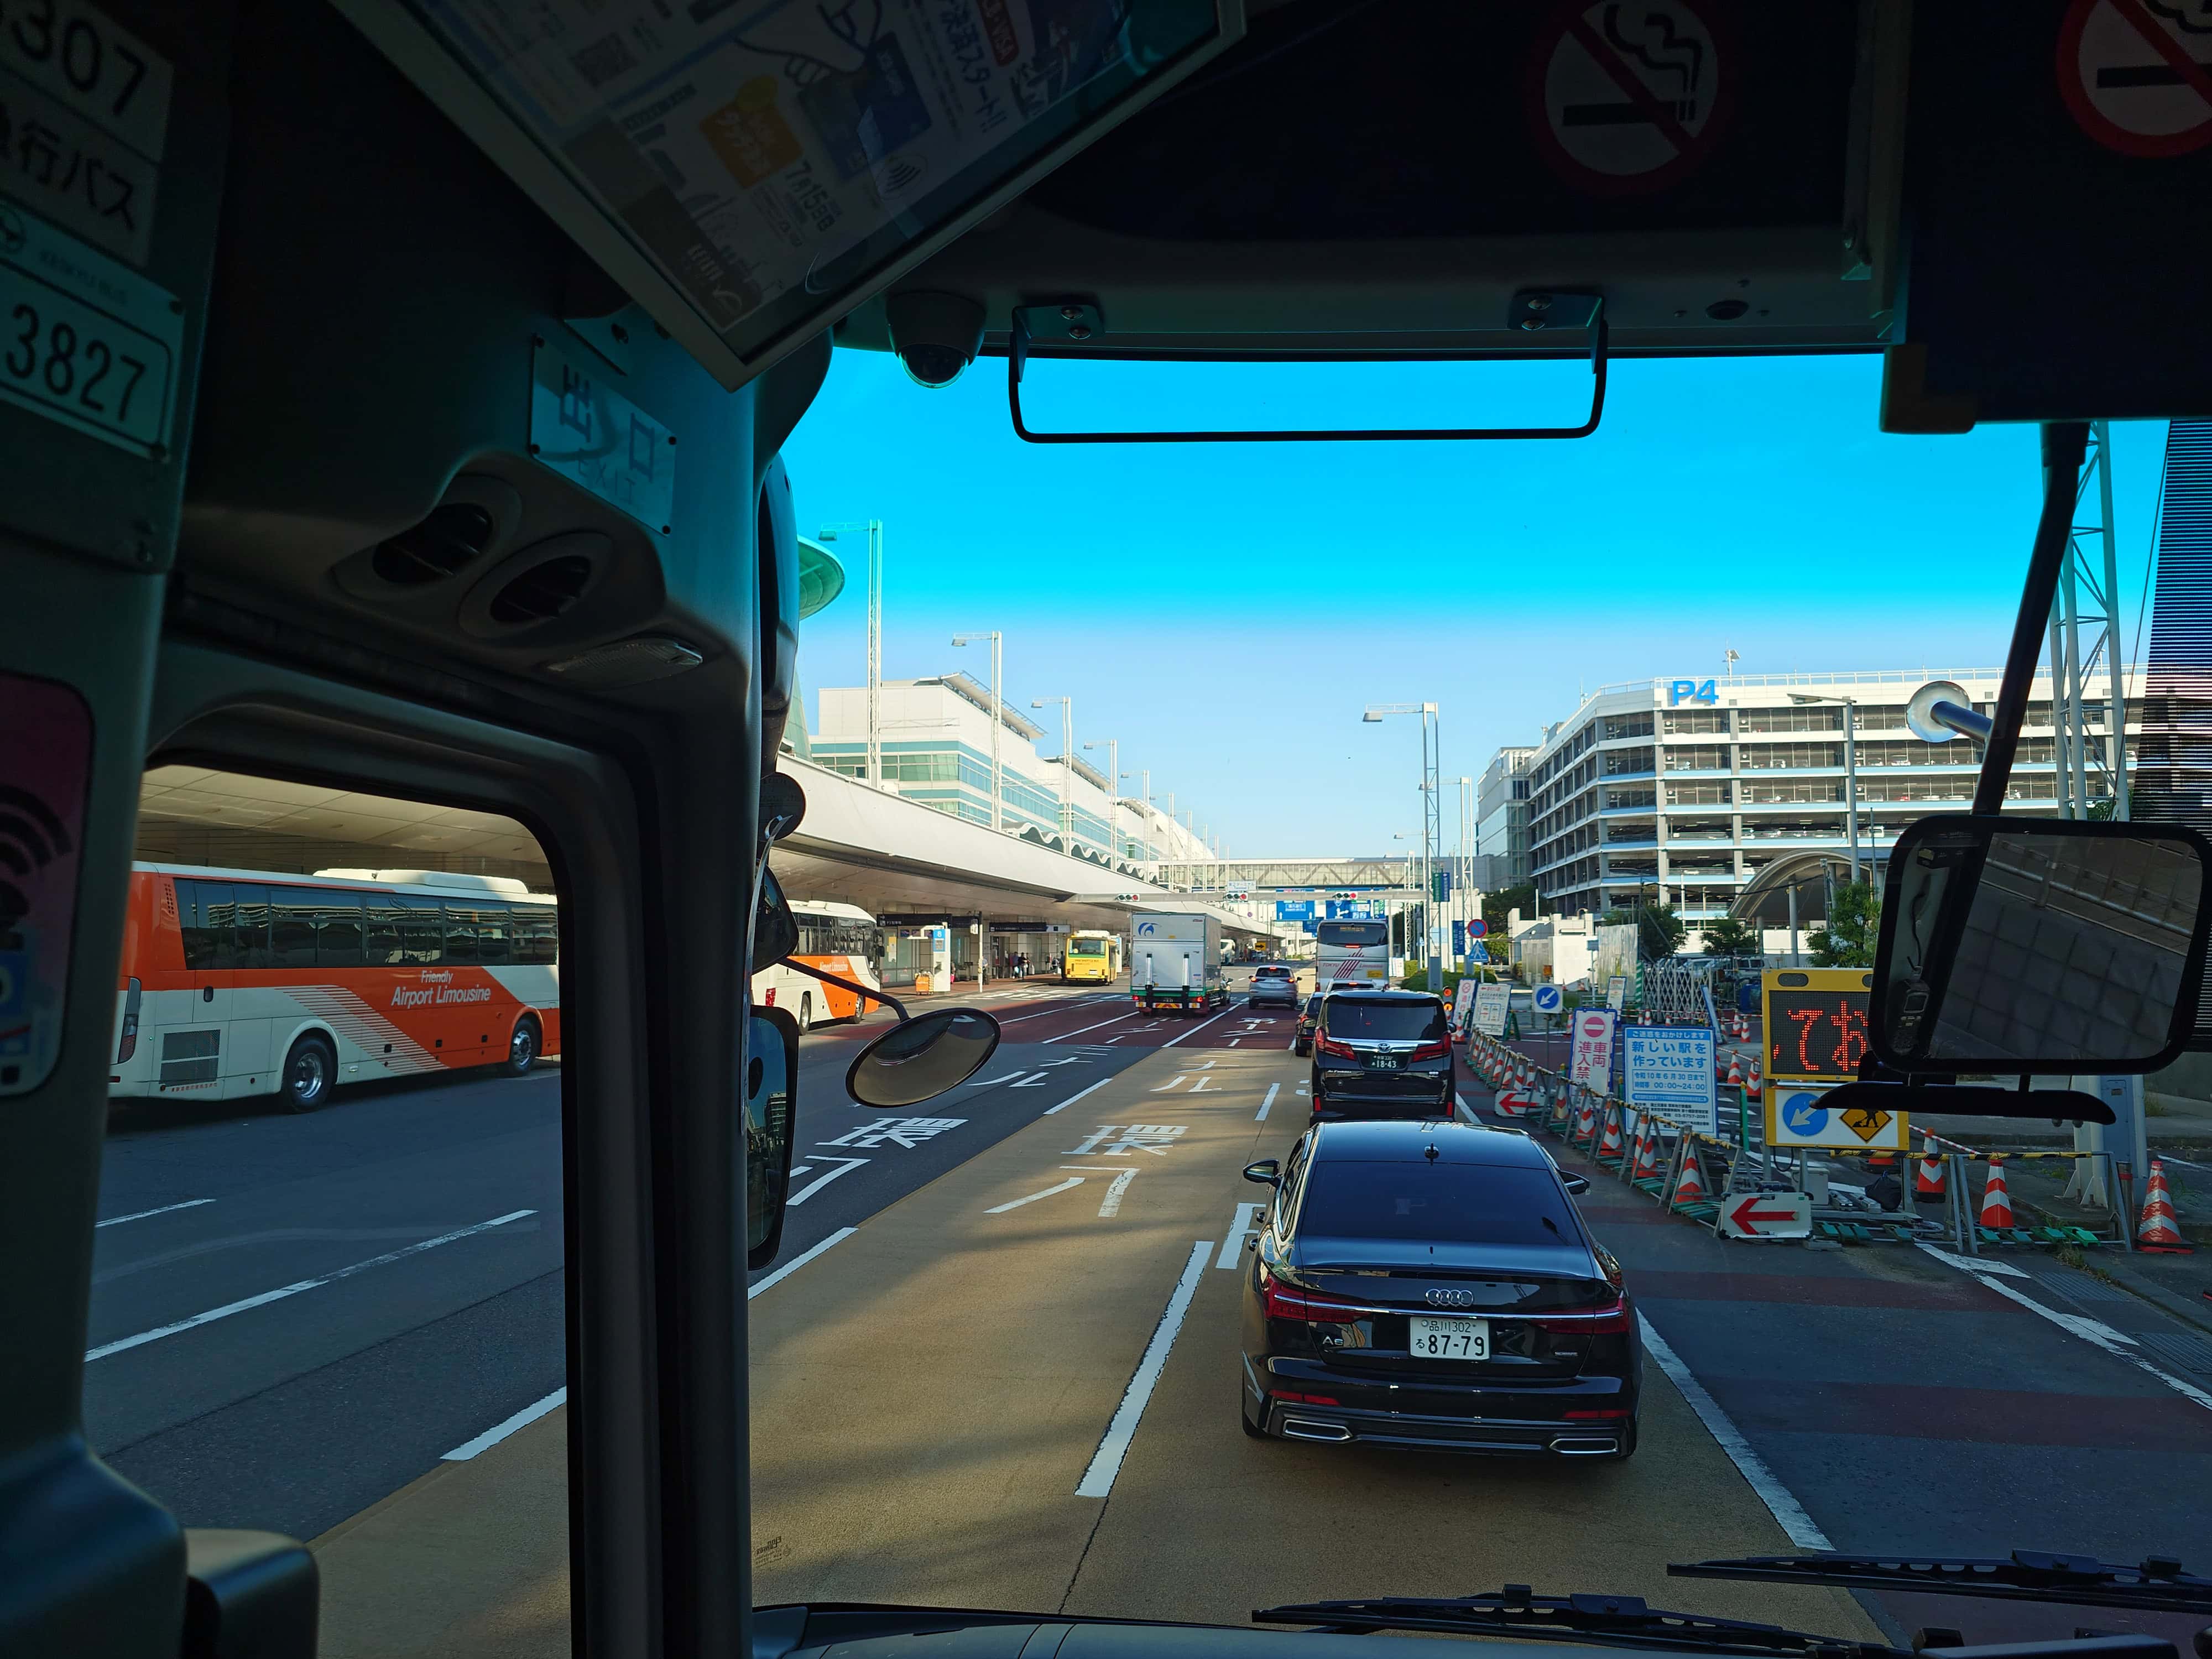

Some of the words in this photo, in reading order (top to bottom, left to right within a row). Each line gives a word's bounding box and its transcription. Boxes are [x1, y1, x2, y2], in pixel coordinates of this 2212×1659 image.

[7, 304, 146, 421] 3827
[560, 364, 654, 483] 出口
[1673, 680, 1719, 705] P4
[421, 969, 453, 984] Friendly
[391, 986, 434, 1009] Airport
[435, 984, 491, 1004] Limousine
[1592, 1042, 1608, 1067] 車両
[1632, 1041, 1707, 1054] 新しい駅を
[1577, 1041, 1593, 1081] 進入禁
[1633, 1055, 1707, 1068] 作っています
[1322, 1335, 1344, 1347] A6
[1428, 1334, 1485, 1357] 87-79
